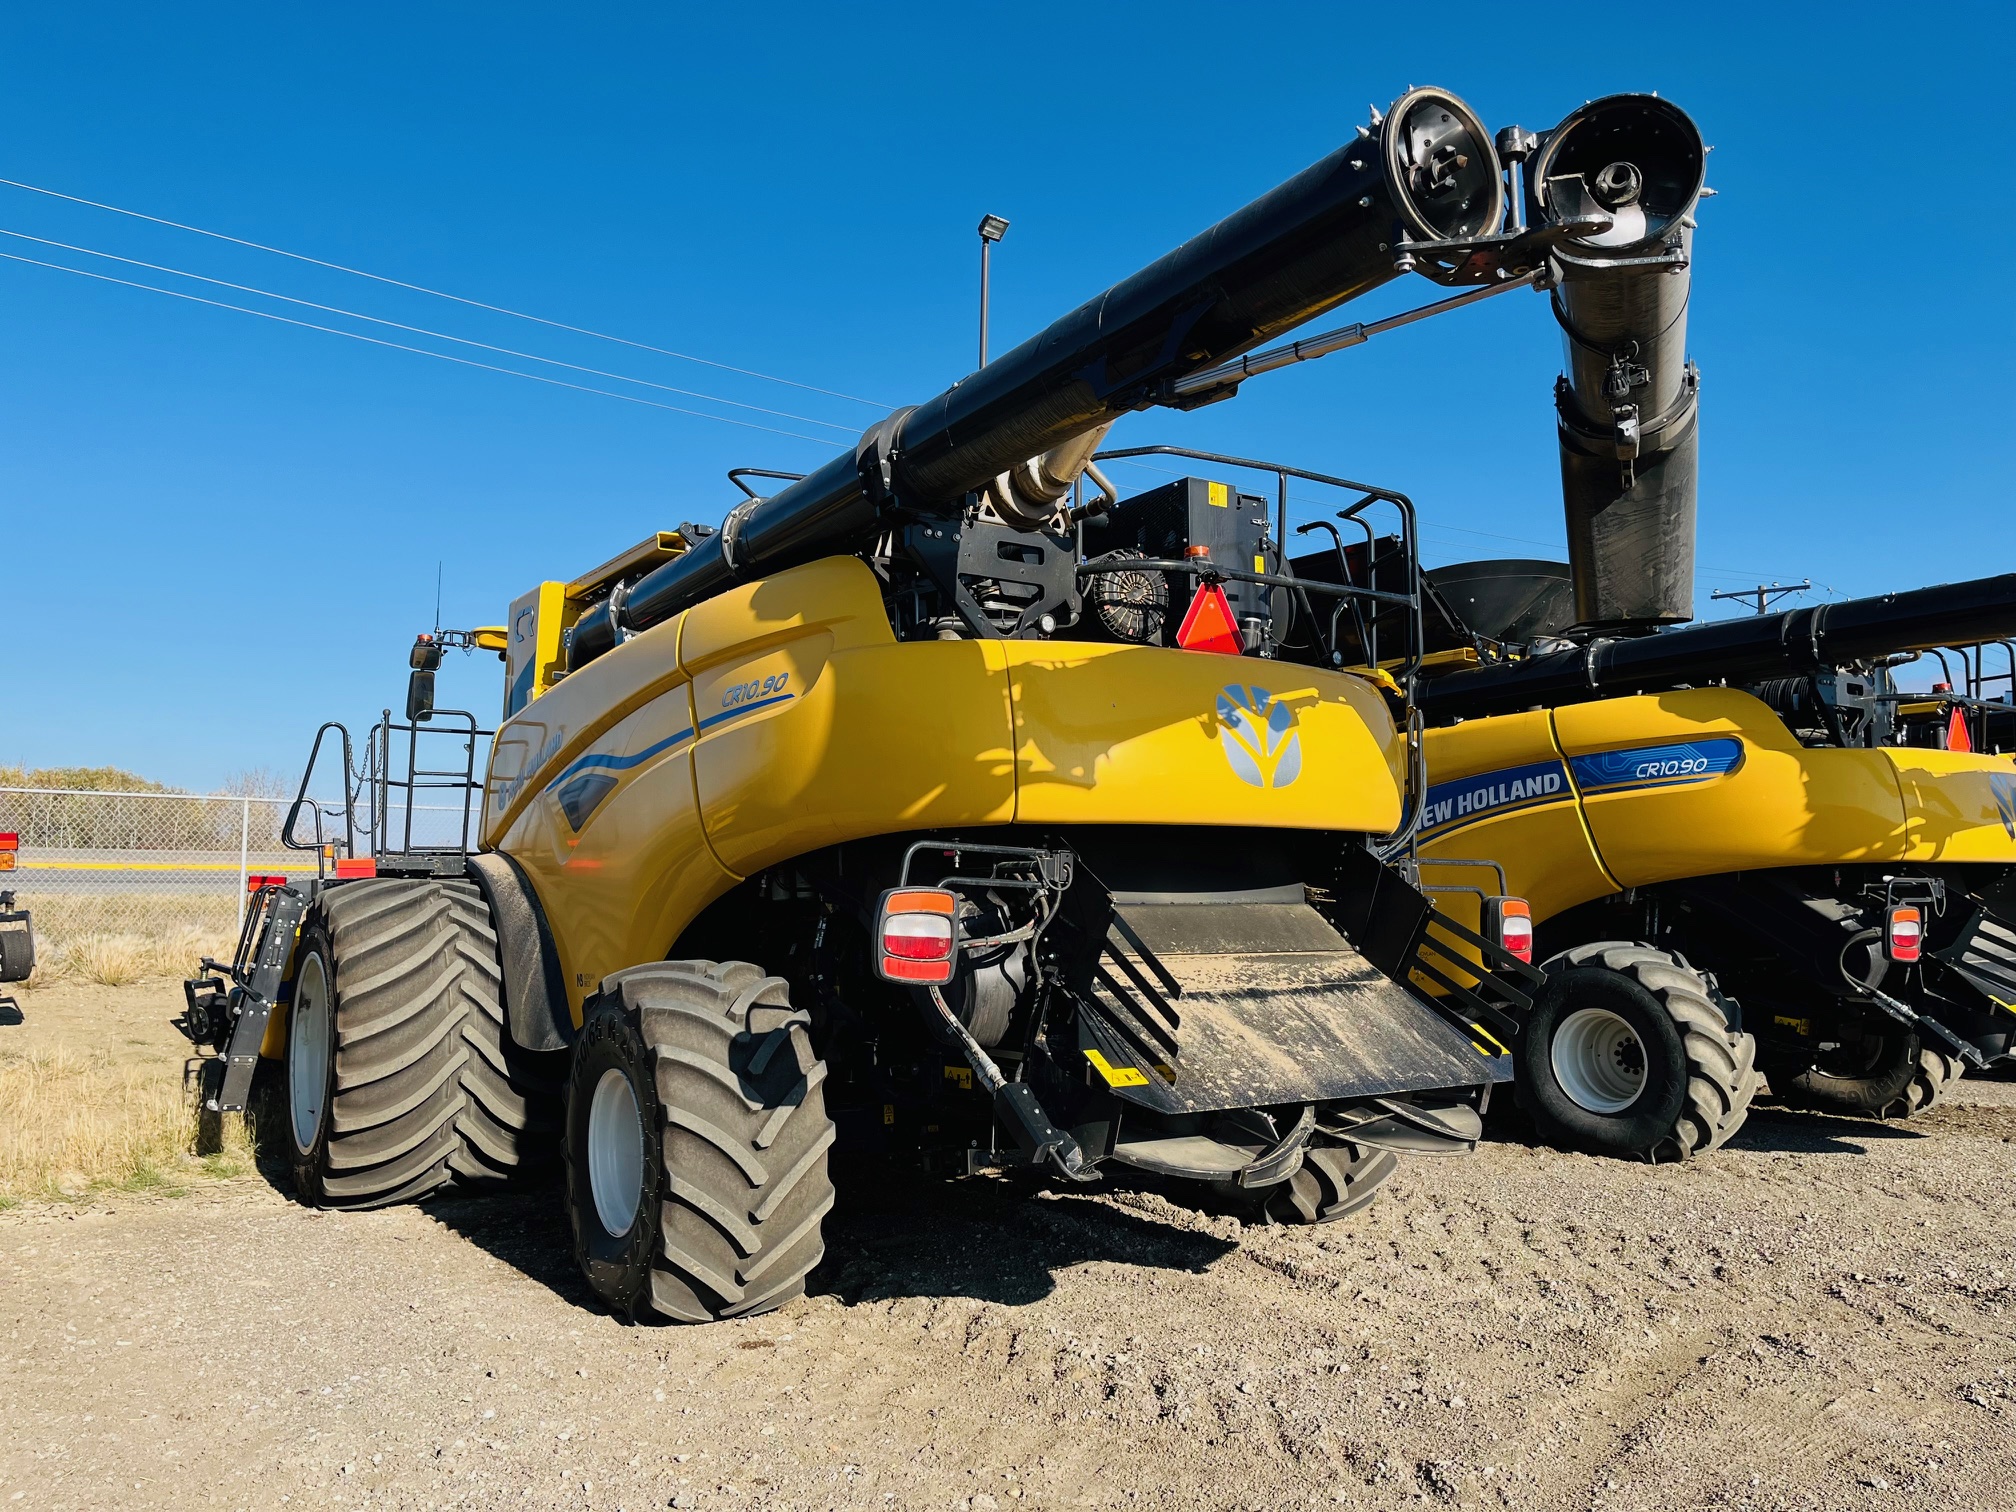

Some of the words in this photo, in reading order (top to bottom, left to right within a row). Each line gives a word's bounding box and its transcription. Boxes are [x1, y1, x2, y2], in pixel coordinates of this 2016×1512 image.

[722, 672, 789, 708] CR10.90
[1636, 758, 1708, 778] CR10.90
[1458, 773, 1562, 816] HOLLAND
